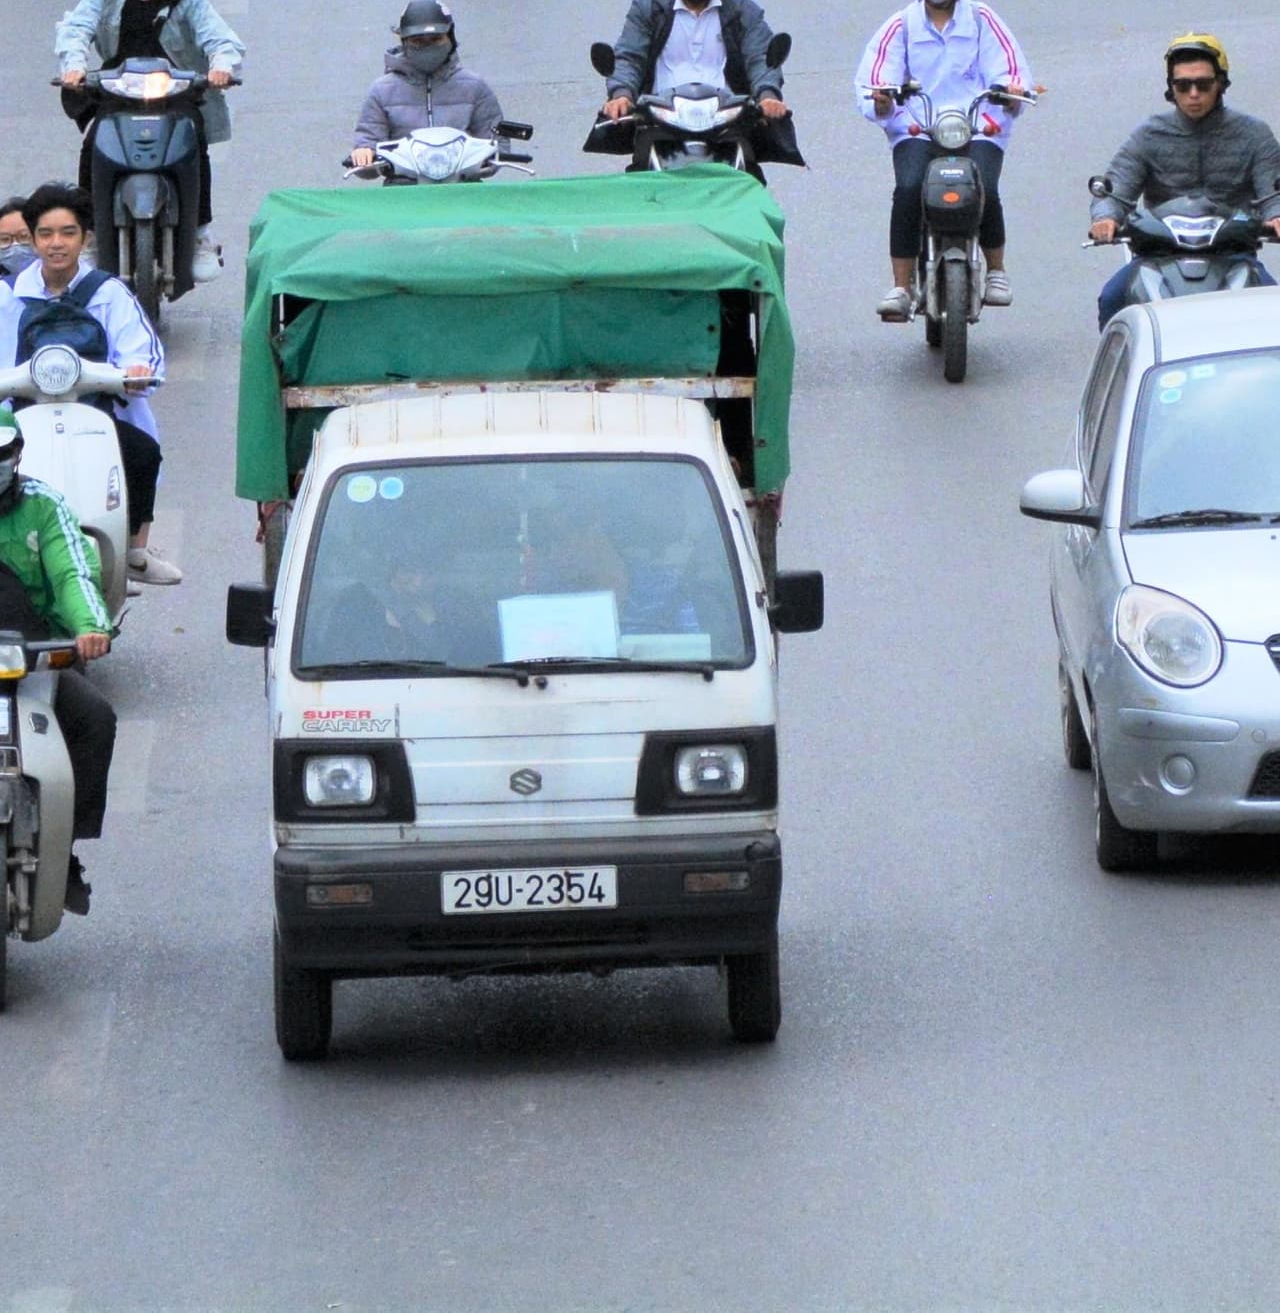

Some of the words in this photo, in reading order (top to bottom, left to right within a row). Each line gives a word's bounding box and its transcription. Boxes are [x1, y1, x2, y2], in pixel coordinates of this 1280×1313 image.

[303, 710, 372, 719] SUPER
[302, 719, 392, 733] CARRY
[454, 871, 606, 909] 29U-2354
